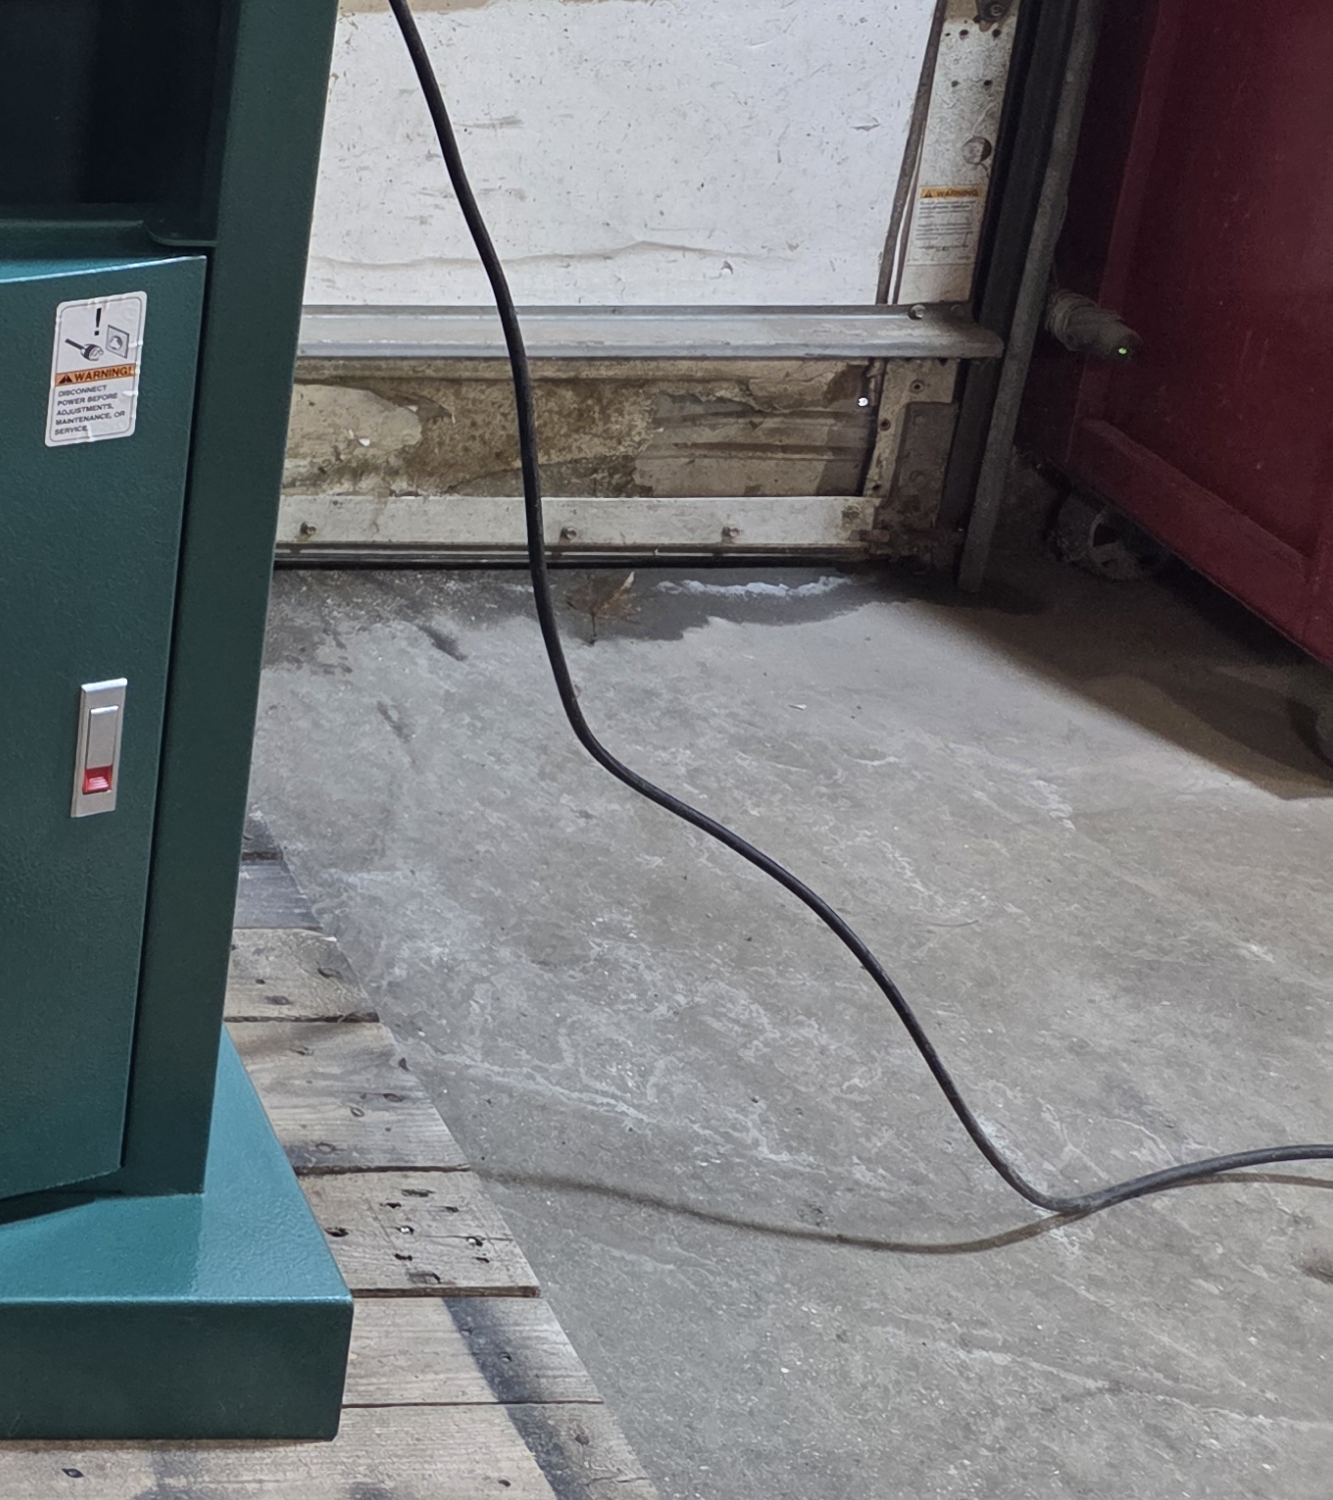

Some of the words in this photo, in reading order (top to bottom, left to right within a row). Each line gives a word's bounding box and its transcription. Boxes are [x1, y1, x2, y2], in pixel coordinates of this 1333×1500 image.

[74, 366, 132, 382] WARNING!
[58, 384, 108, 398] DISCONNECT
[57, 397, 86, 406] POWER
[87, 392, 119, 403] BEFORE
[56, 403, 114, 416] ADJUSTMENTS,
[55, 414, 112, 426] MAINTENANCE,
[114, 410, 126, 418] OR
